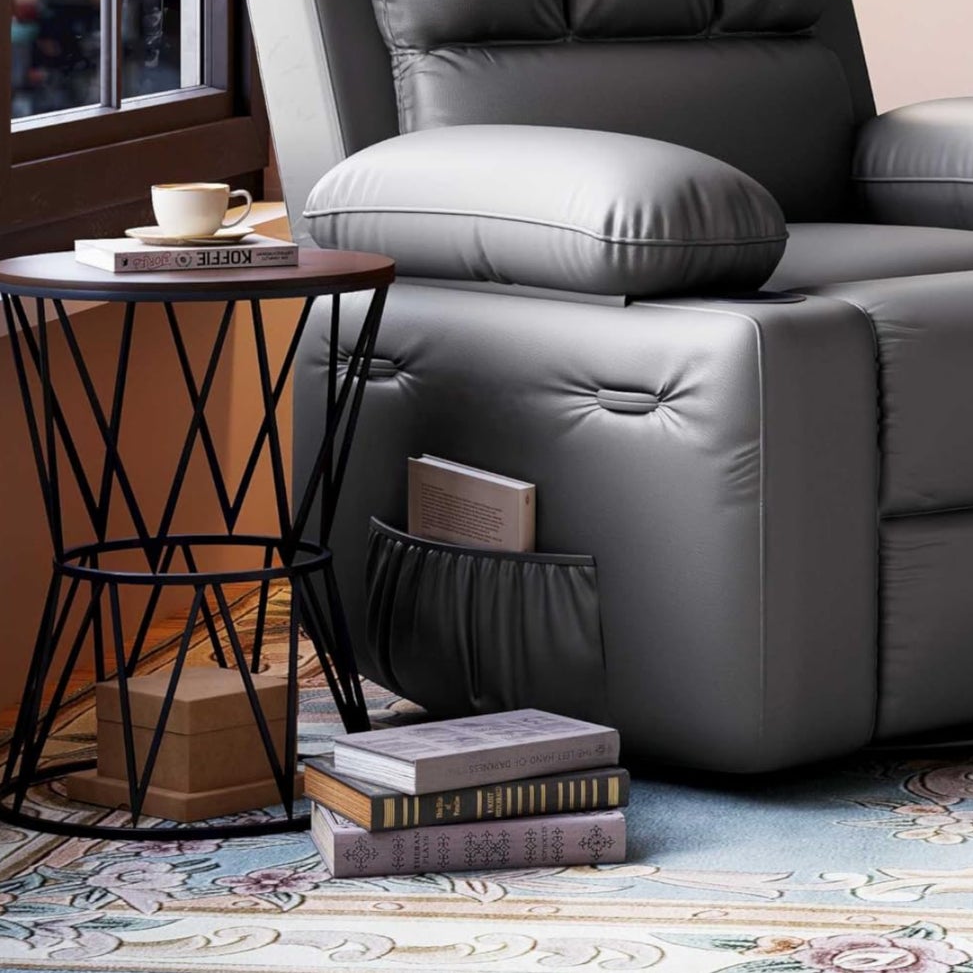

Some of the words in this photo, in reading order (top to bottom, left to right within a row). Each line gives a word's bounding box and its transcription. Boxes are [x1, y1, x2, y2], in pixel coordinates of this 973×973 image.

[196, 249, 252, 266] KOFFIE
[514, 759, 527, 768] OF
[530, 755, 554, 765] HAND
[422, 834, 430, 865] PLAYS
